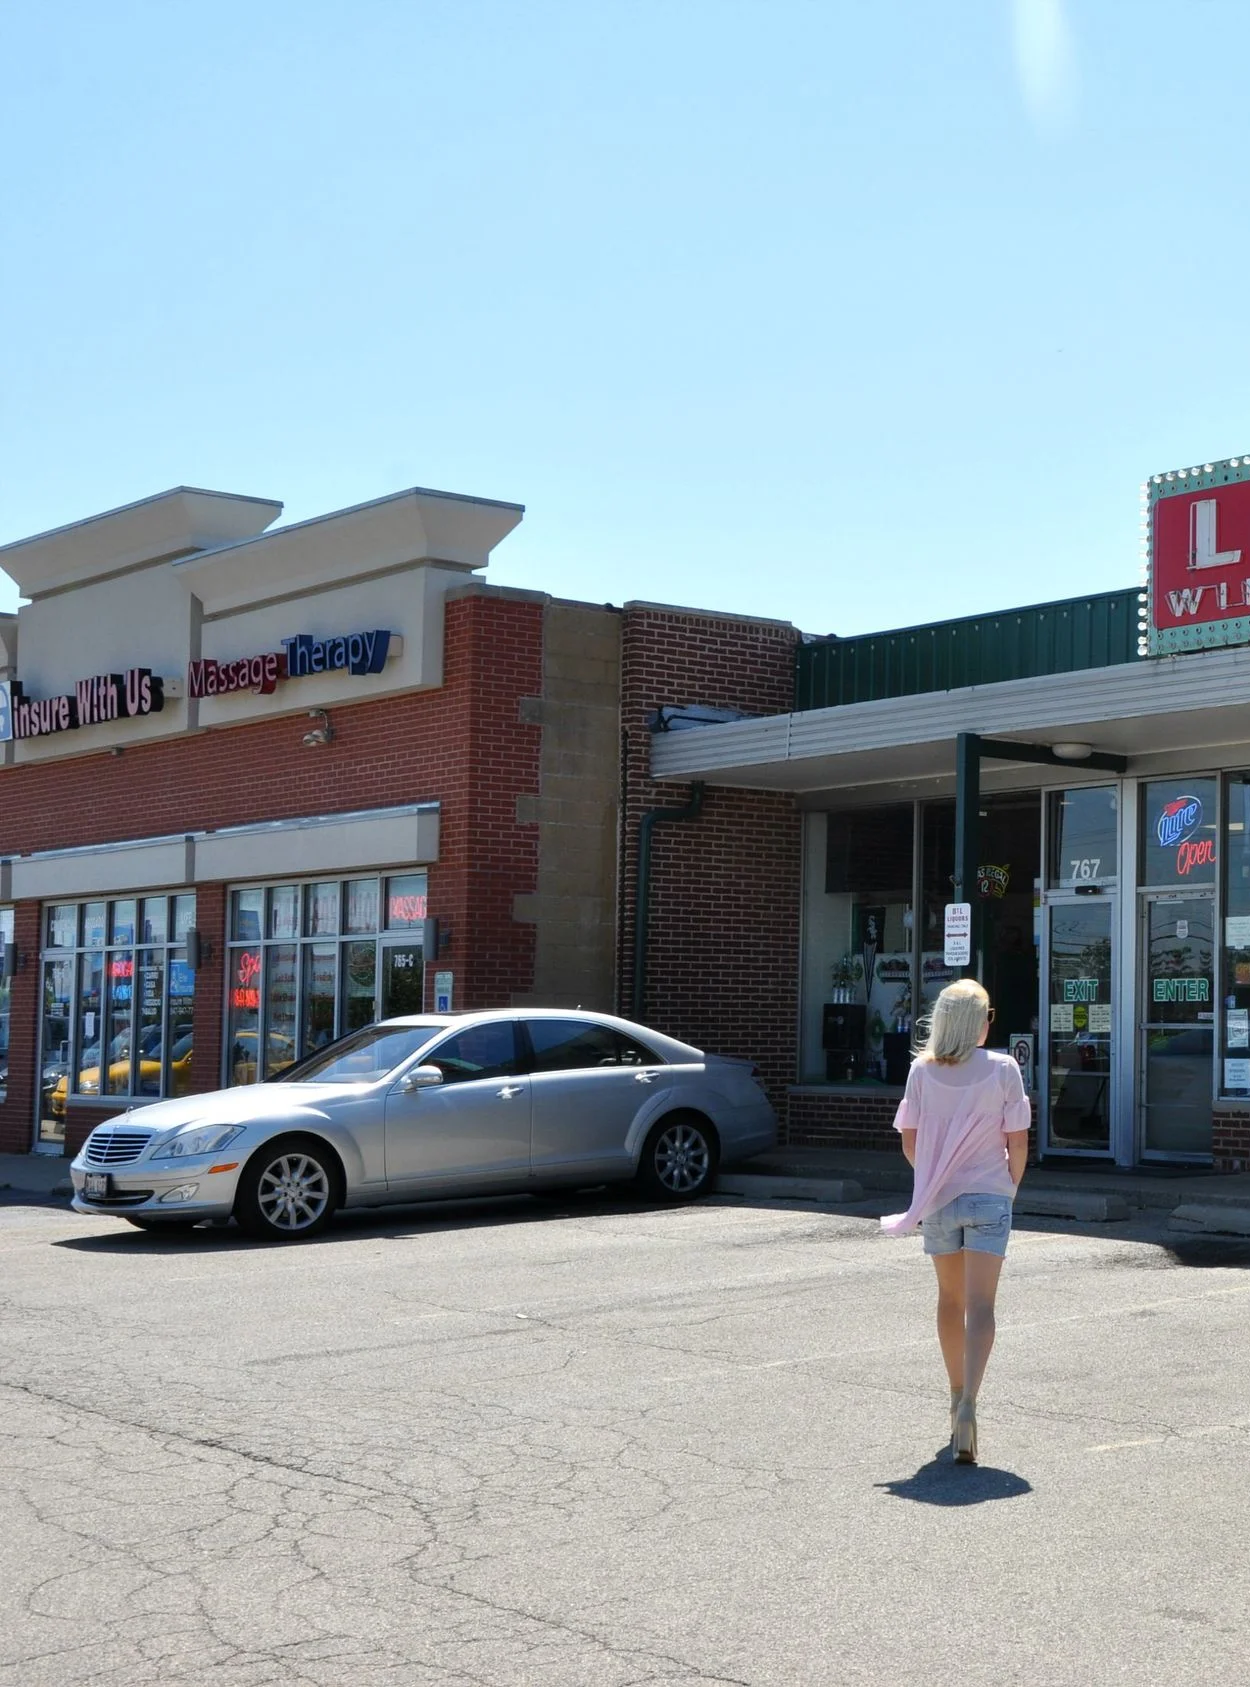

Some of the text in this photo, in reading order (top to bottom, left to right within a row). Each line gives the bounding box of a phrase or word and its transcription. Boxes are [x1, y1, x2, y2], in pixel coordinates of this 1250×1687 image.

[187, 630, 379, 698] Massage Therapy
[126, 668, 151, 716] Us
[1070, 859, 1100, 880] 767
[1177, 840, 1217, 875] Open
[1063, 978, 1099, 1001] EXIT
[1153, 978, 1209, 1001] ENTER
